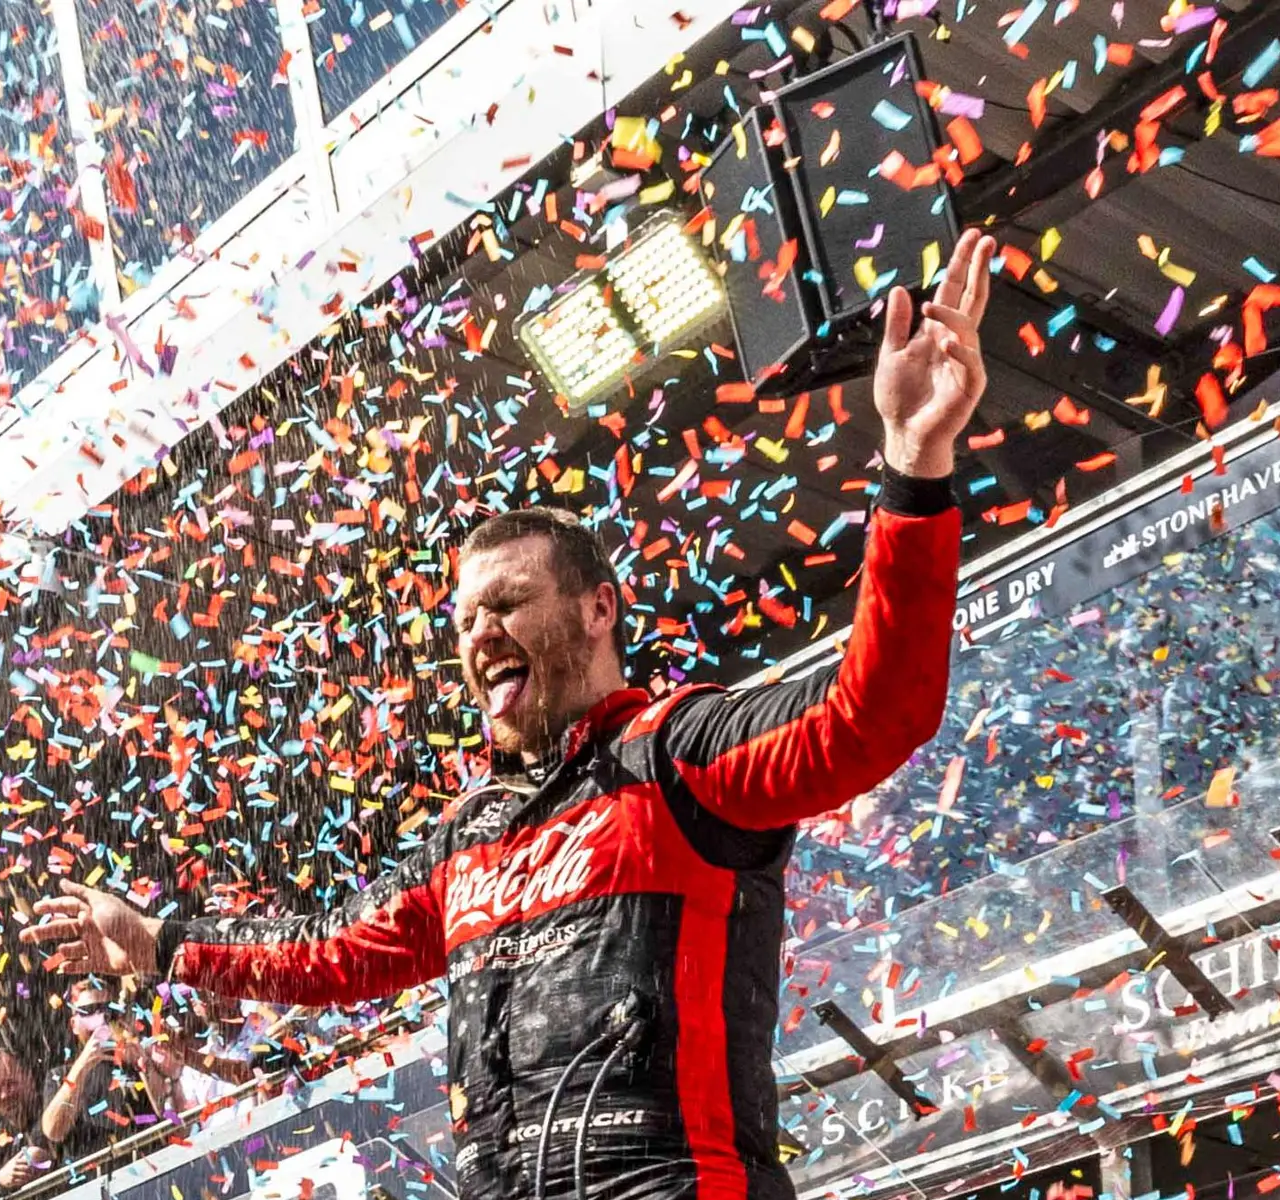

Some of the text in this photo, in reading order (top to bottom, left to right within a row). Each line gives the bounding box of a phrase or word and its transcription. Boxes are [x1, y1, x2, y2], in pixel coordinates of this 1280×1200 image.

[952, 561, 1057, 631] ONE DRY
[507, 1109, 645, 1144] KOSTCKI
[788, 1057, 1009, 1147] ESCKE
